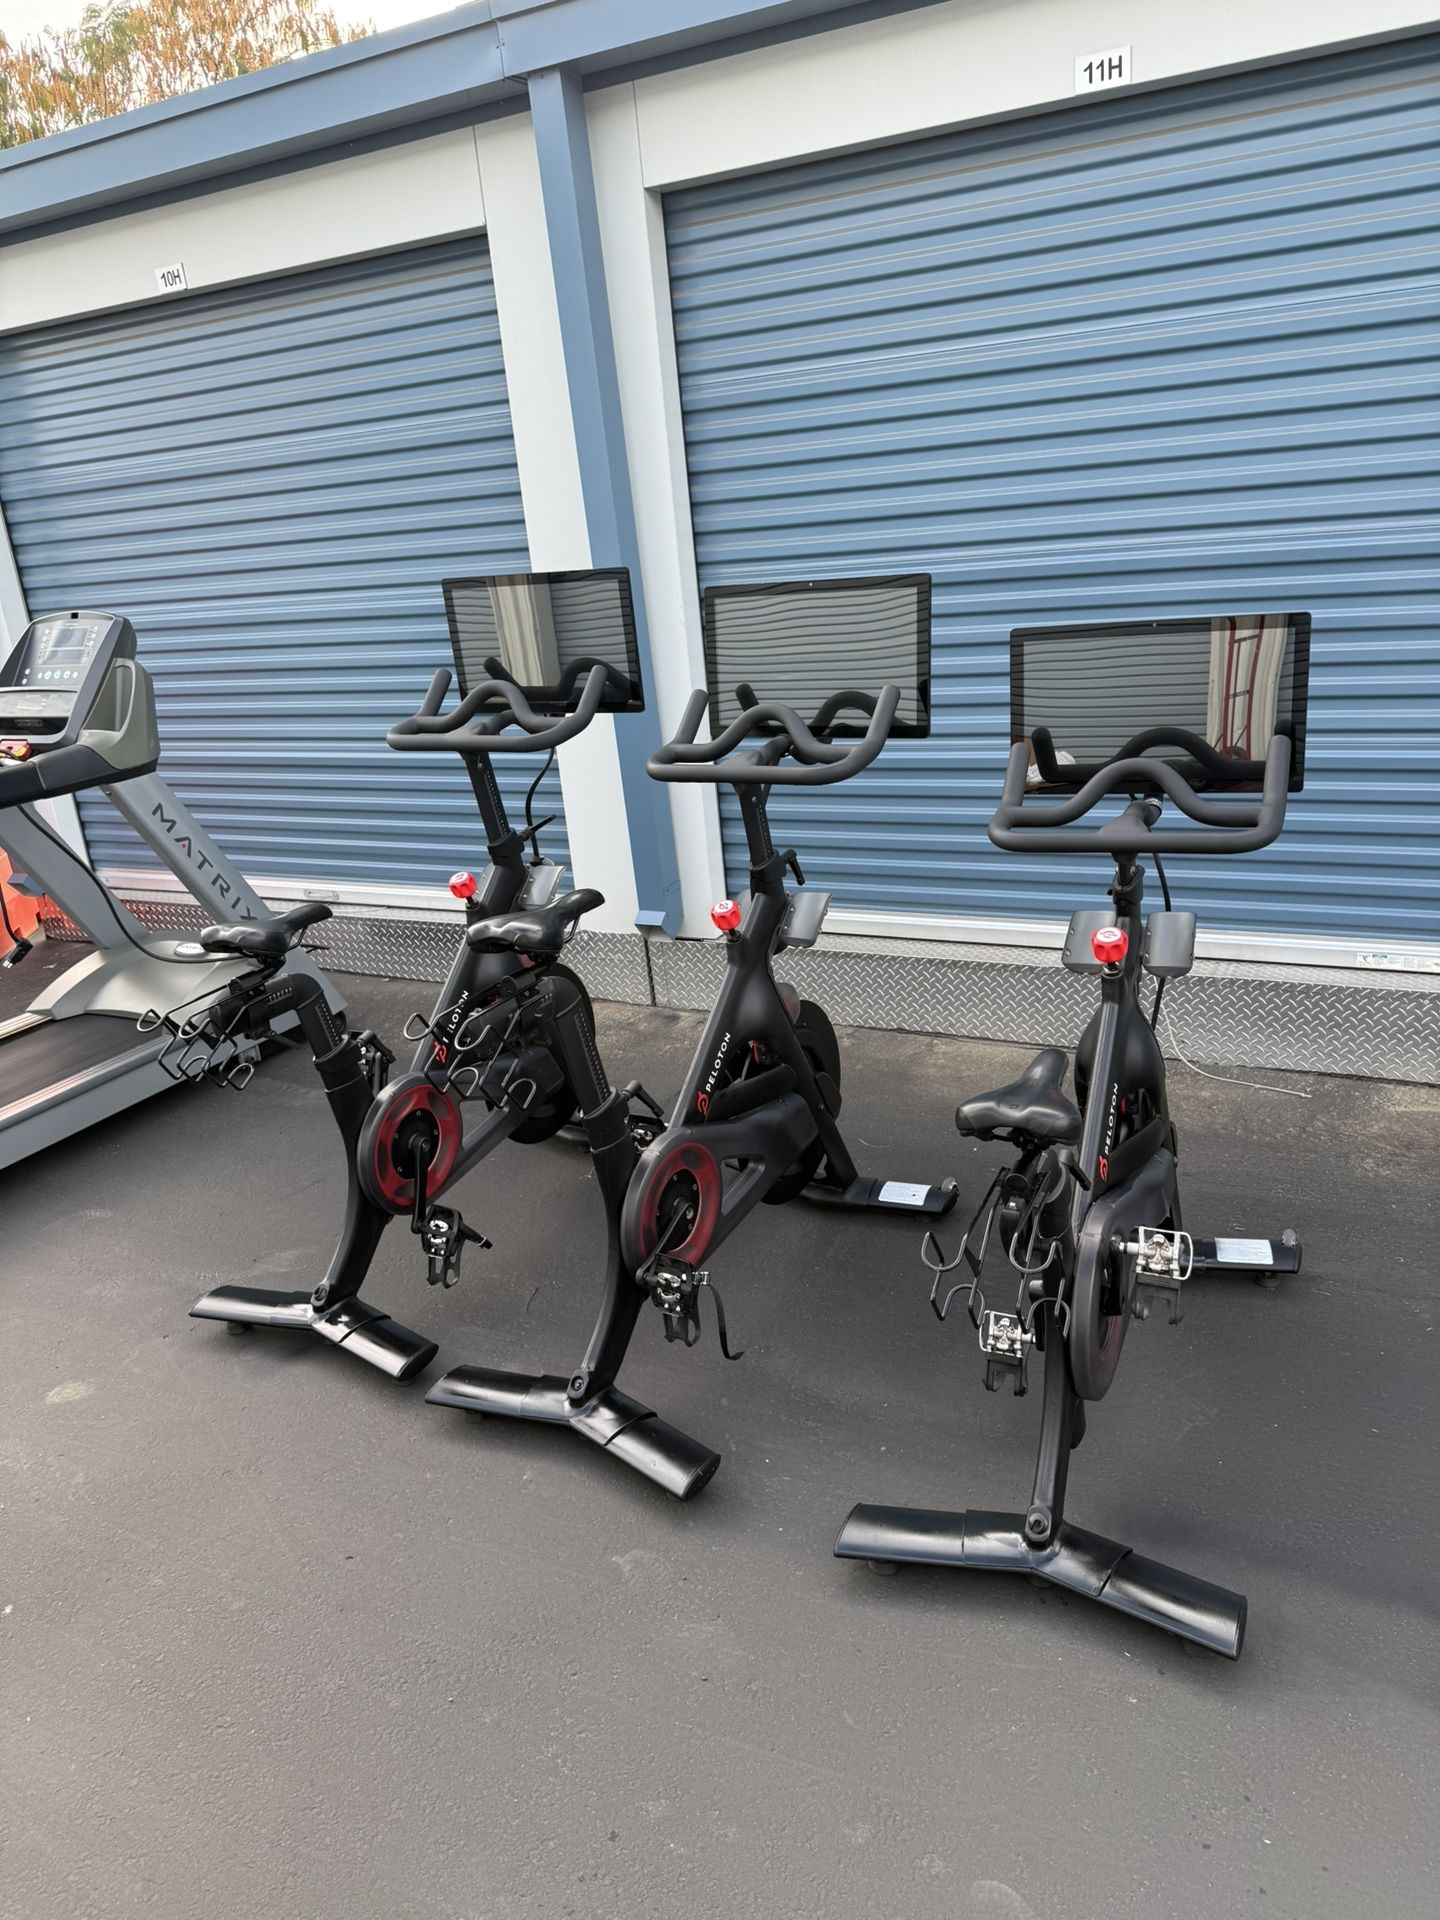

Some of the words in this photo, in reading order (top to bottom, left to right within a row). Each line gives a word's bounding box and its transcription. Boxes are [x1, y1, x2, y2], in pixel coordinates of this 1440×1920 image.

[1083, 54, 1122, 84] 11H
[160, 269, 182, 287] 10H
[151, 802, 258, 920] MATRIX
[705, 1032, 731, 1092] PELOTON
[1104, 1083, 1118, 1155] PELOTON
